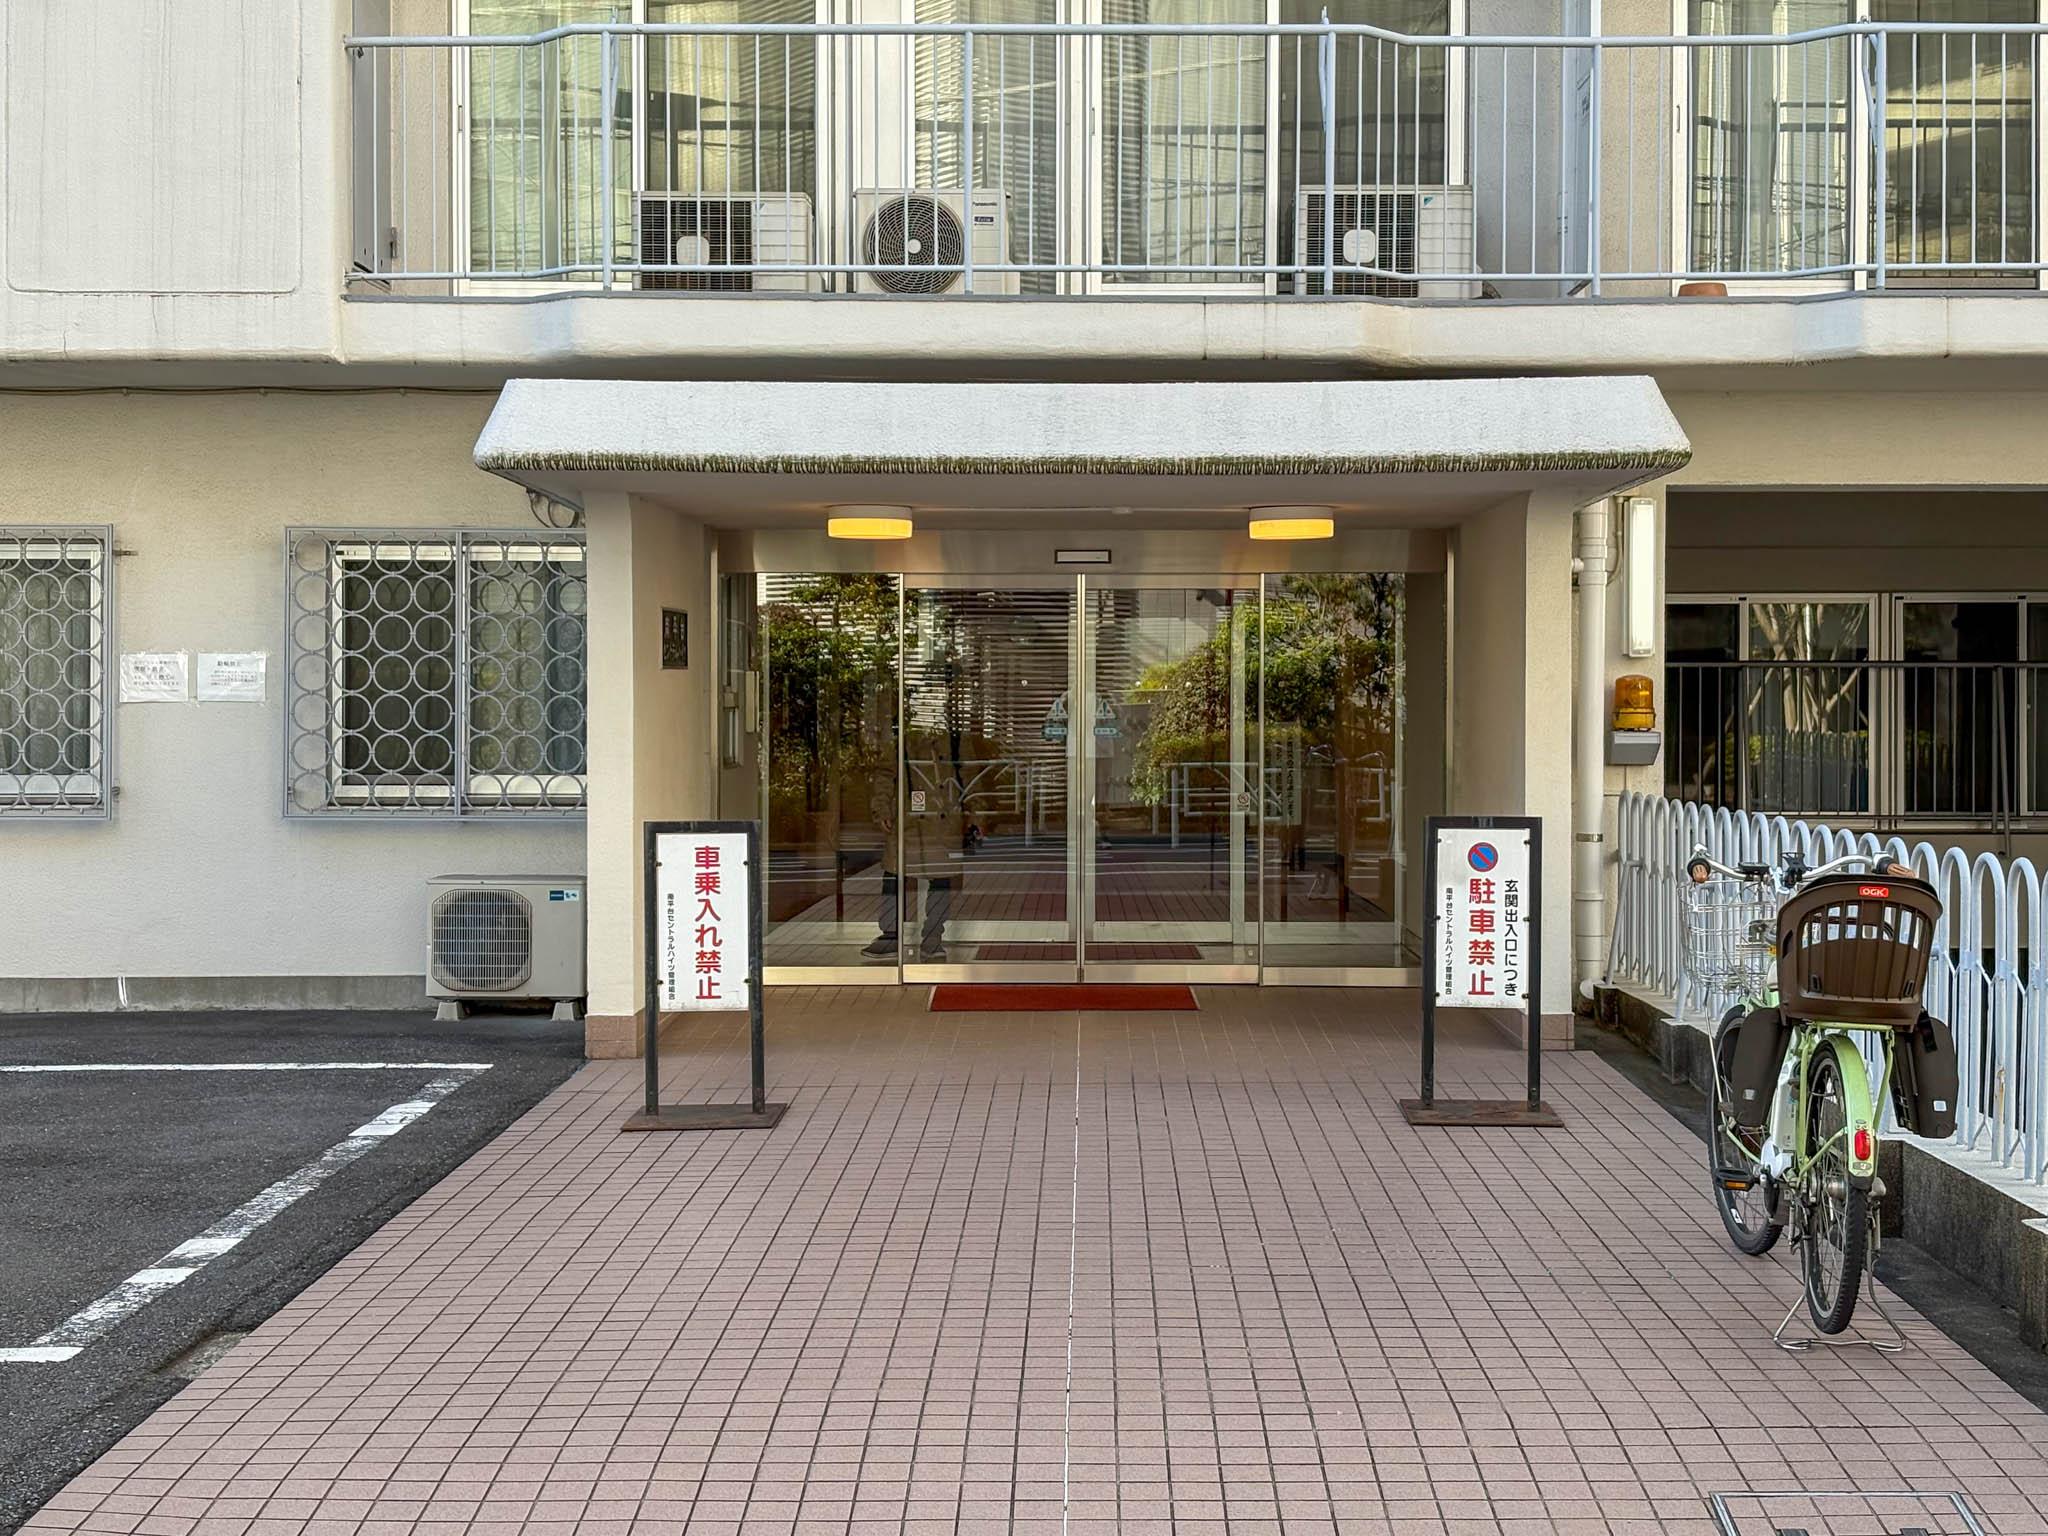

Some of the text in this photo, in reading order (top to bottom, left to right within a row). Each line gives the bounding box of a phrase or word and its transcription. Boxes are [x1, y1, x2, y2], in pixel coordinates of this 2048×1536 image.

[694, 845, 723, 1000] 車乗入れ禁止
[1445, 887, 1453, 995] 南平台セントラルハイツ管理組合
[1467, 878, 1496, 997] 駐車禁止
[1503, 879, 1519, 997] 玄関出入口につき
[1862, 887, 1885, 896] OGK
